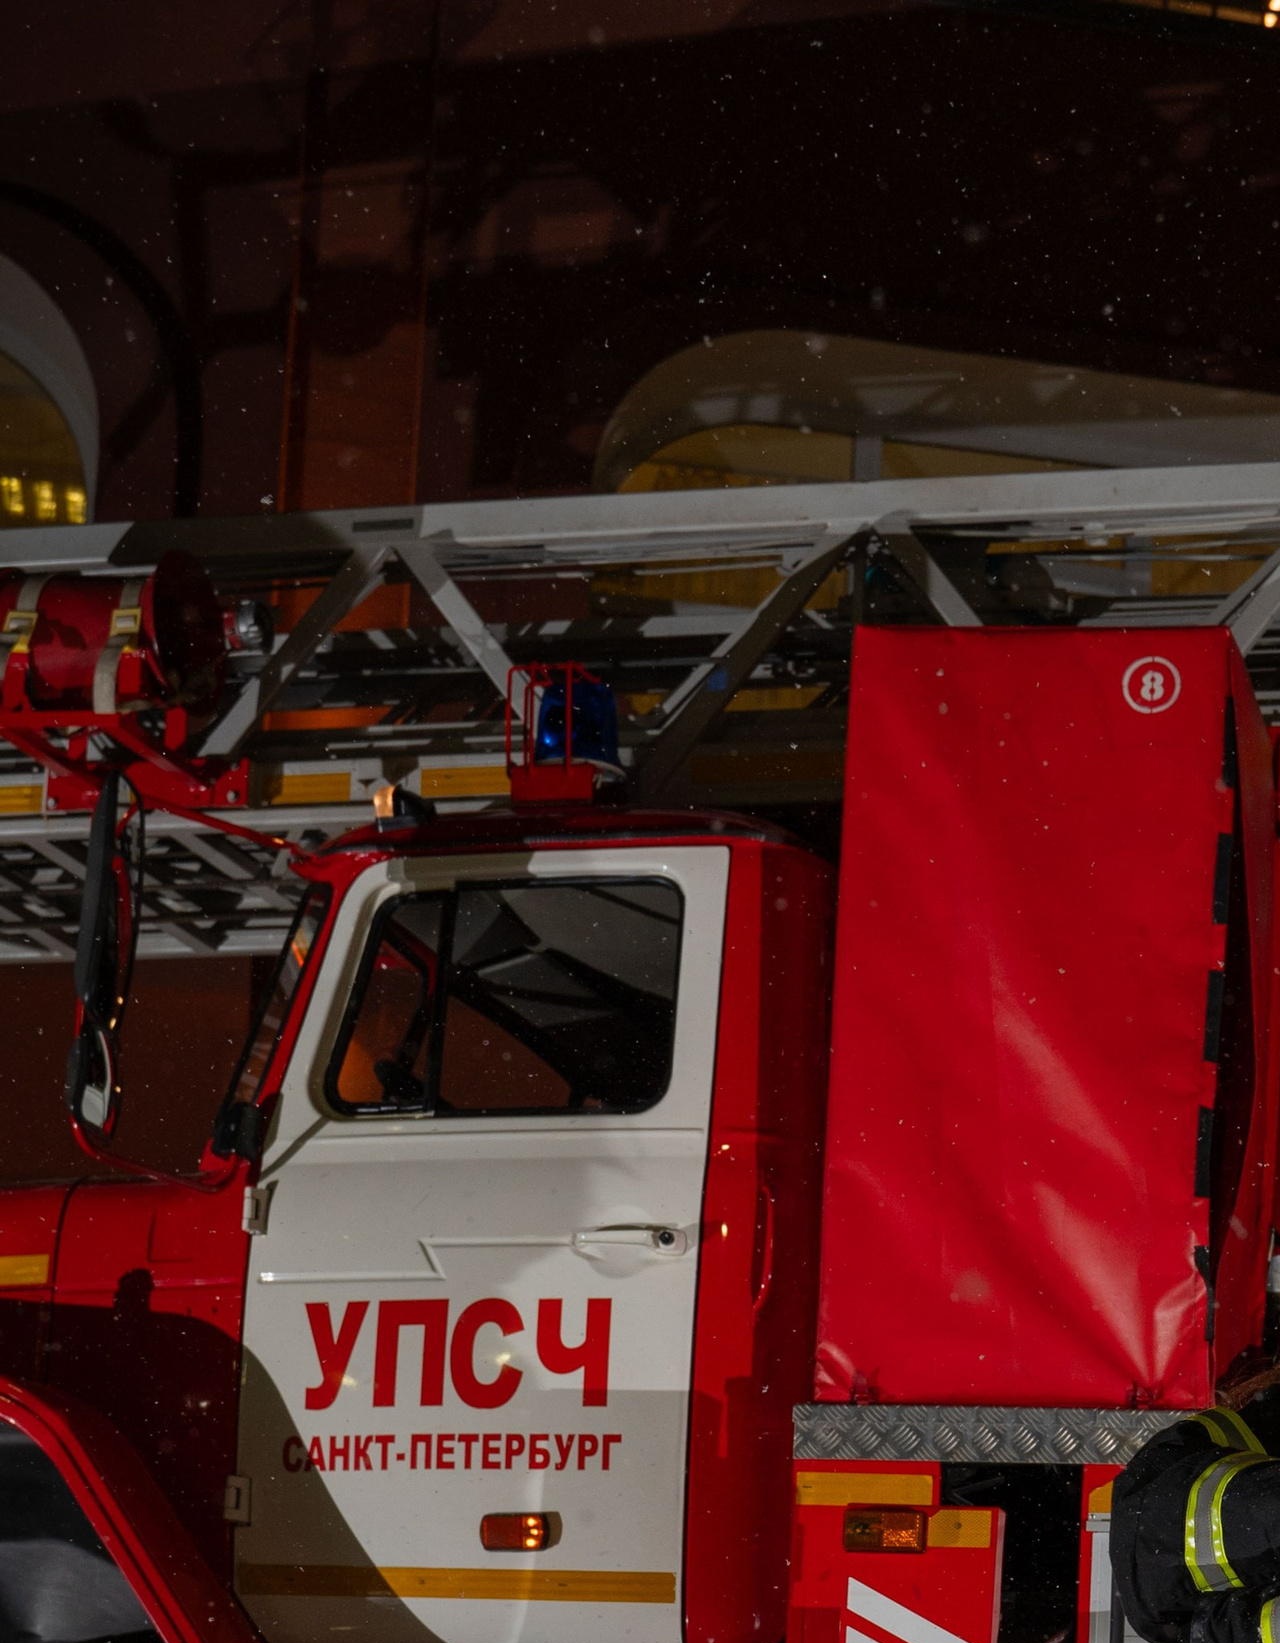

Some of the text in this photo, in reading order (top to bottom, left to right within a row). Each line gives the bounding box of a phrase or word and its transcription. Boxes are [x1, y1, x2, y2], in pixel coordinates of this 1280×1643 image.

[1140, 670, 1165, 701] 8
[304, 1297, 613, 1410] УПСЧ
[282, 1433, 622, 1473] САНКТ-ПЕТЕРБУРГ
